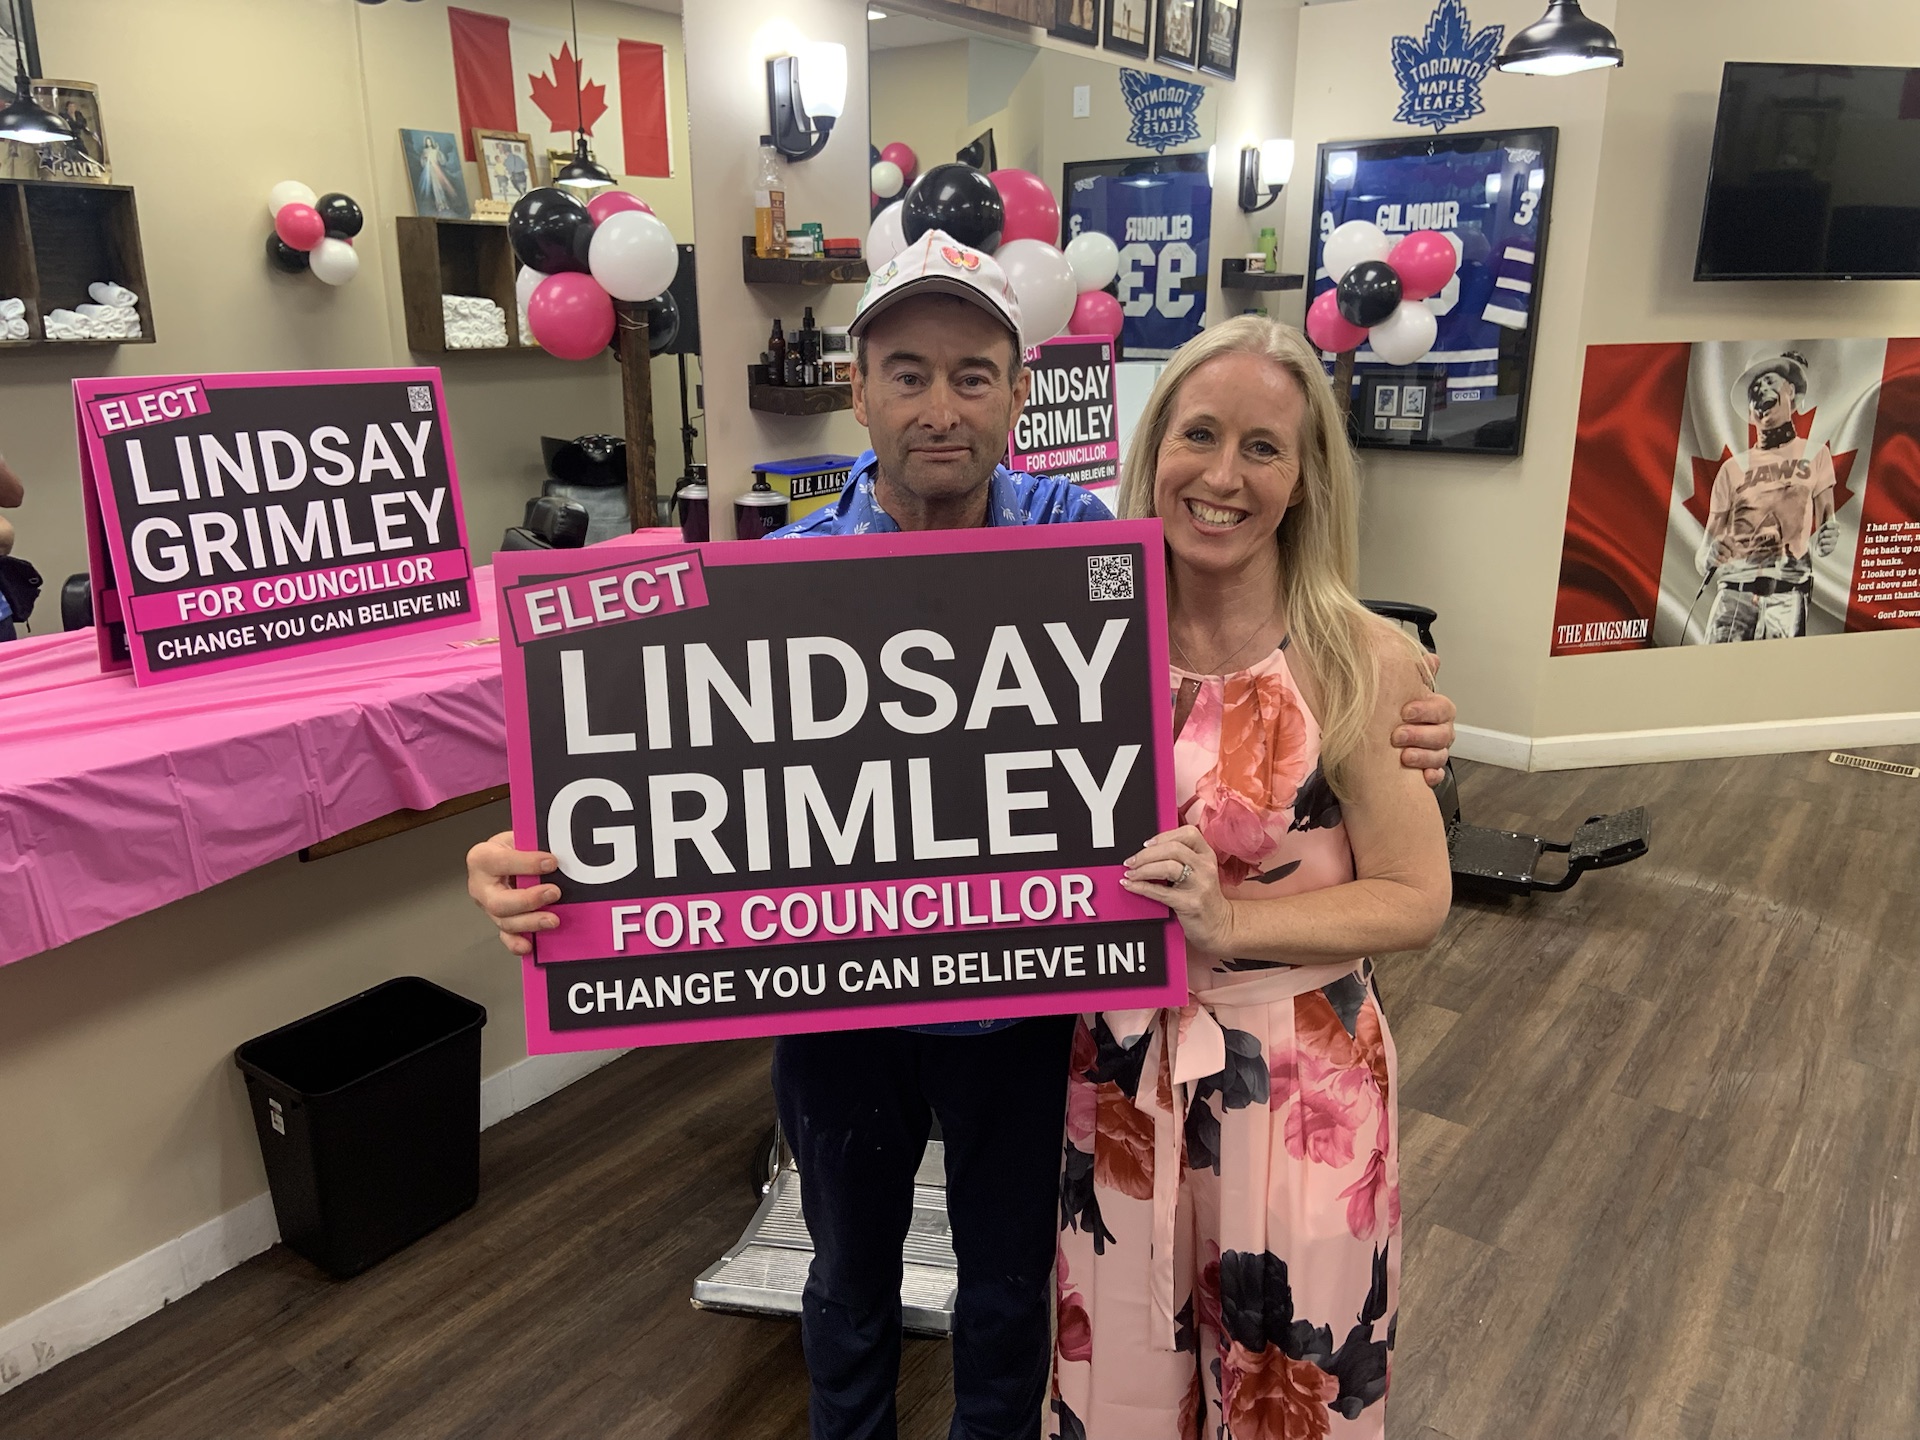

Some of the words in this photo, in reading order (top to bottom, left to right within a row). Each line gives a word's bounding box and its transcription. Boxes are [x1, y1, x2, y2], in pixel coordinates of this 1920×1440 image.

[1409, 57, 1481, 83] TORONTO
[1418, 79, 1466, 95] MAPLE
[1414, 94, 1465, 111] LEAFS
[1375, 200, 1460, 232] GILMOUR
[1513, 191, 1539, 226] 3
[1023, 364, 1110, 407] INDSAY
[99, 385, 199, 432] ELECT
[1014, 404, 1113, 451] GRIMLEY
[125, 419, 433, 506] LINDSAY
[1026, 453, 1050, 471] FOR
[1048, 444, 1107, 467] COUNCILLOR
[792, 478, 812, 495] THE
[1080, 466, 1106, 482] BELIEVE
[1106, 465, 1115, 477] IN!
[1736, 459, 1811, 494] JAWS
[130, 486, 446, 584] GRIMLEY
[1864, 535, 1874, 544] in
[1875, 535, 1889, 543] the
[1890, 533, 1913, 543] river,
[1866, 523, 1872, 532] I
[1872, 522, 1888, 532] had
[1889, 523, 1904, 532] my
[1904, 521, 1920, 530] han
[1861, 558, 1875, 567] the
[1876, 557, 1904, 566] banks.
[1862, 547, 1879, 556] feet
[1880, 545, 1901, 555] back
[1901, 546, 1912, 555] up
[1857, 581, 1875, 591] lord
[1876, 581, 1901, 590] above
[1901, 579, 1918, 588] and
[1861, 570, 1867, 579] I
[1867, 568, 1895, 579] looked
[1896, 569, 1907, 578] up
[1908, 568, 1917, 576] to
[177, 585, 245, 621] FOR
[253, 556, 435, 609] COUNCILLOR
[524, 560, 692, 637] ELECT
[1857, 594, 1874, 604] hey
[1874, 593, 1893, 602] man
[1894, 590, 1920, 600] thank
[157, 624, 257, 661] CHANGE
[259, 617, 306, 642] YOU
[309, 609, 355, 633] CAN
[358, 596, 433, 625] BELIEVE
[437, 589, 462, 609] IN!
[1877, 611, 1897, 619] Gord
[1557, 624, 1583, 645] THE
[1584, 618, 1649, 642] KINGSMEN
[559, 618, 1131, 756] LINDSAY
[546, 744, 1142, 886] GRIMLEY
[609, 900, 723, 952] FOR
[739, 872, 1096, 938] COUNCILLOR
[566, 969, 736, 1015] CHANGE
[747, 963, 828, 1001] YOU
[837, 958, 921, 992] CAN
[931, 946, 1086, 986] BELIEVE
[1097, 941, 1147, 974] IN!
